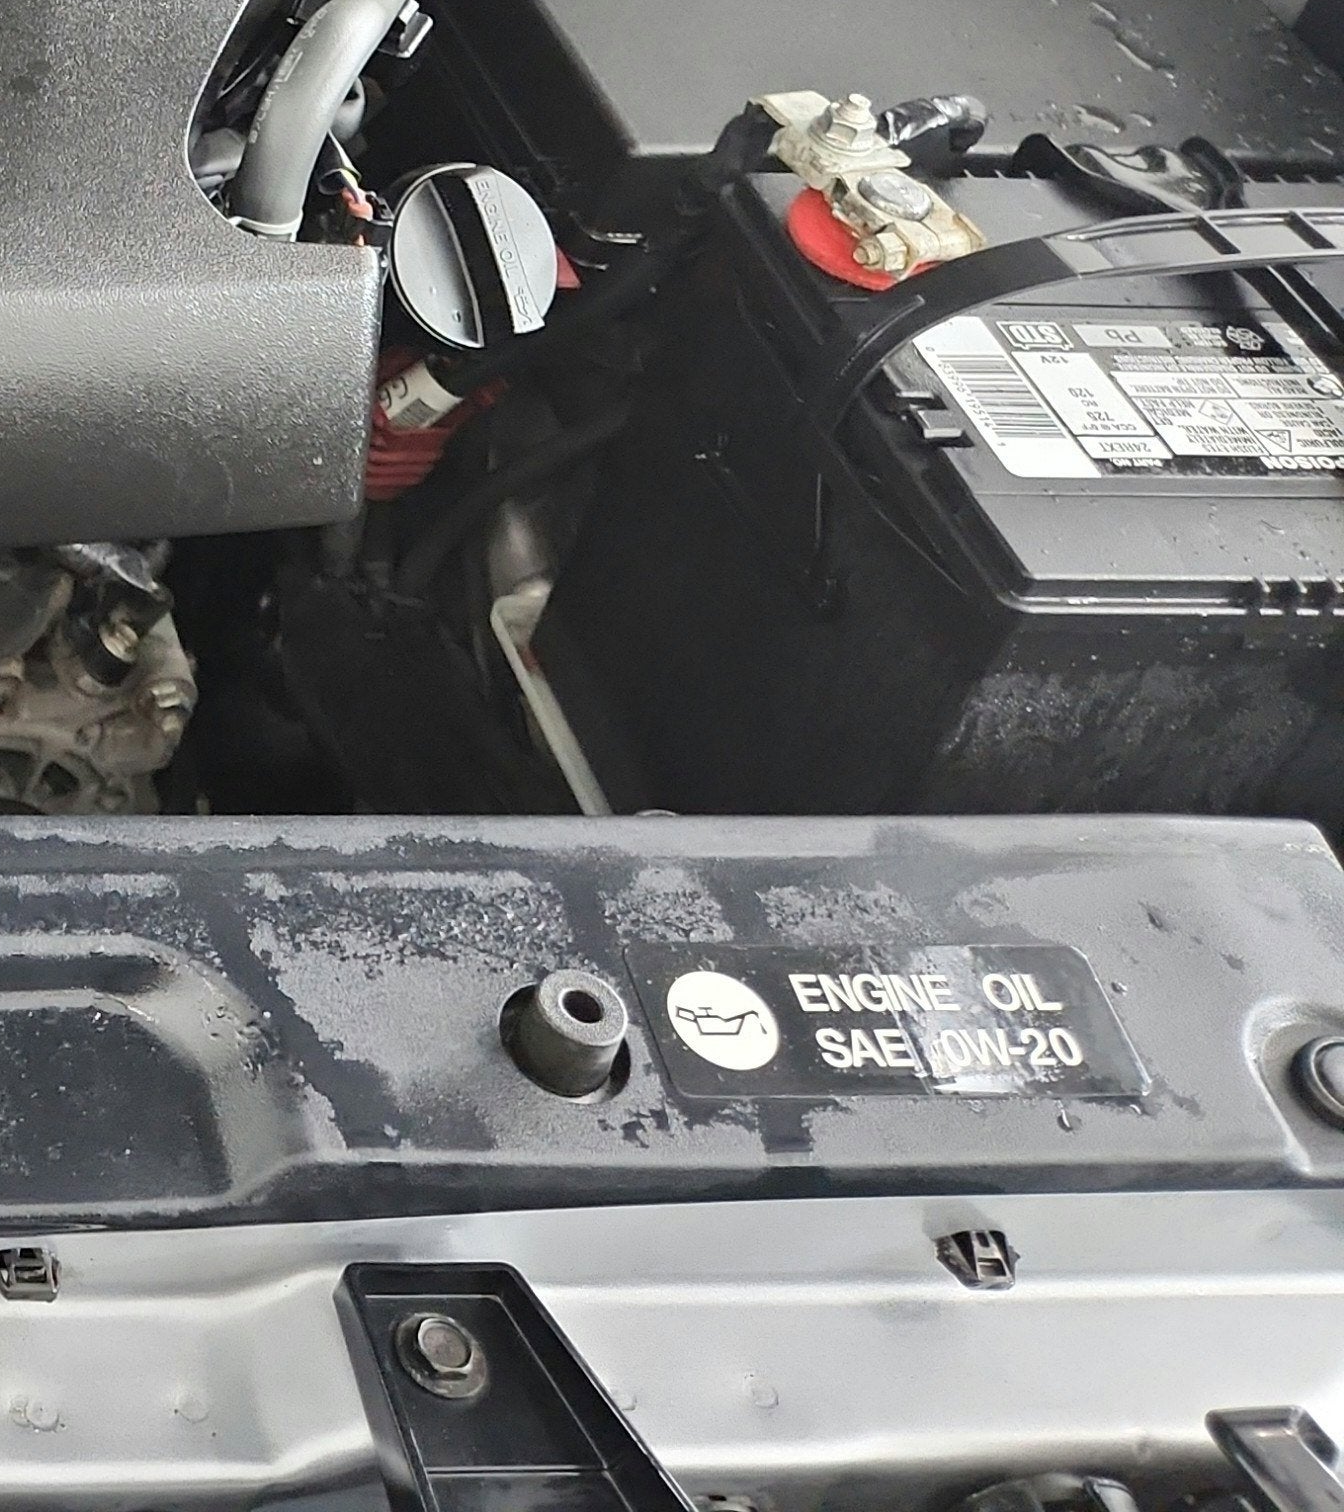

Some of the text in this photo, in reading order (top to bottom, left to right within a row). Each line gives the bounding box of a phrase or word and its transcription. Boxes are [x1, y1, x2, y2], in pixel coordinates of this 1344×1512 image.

[473, 178, 520, 279] ENGINE OIL
[1006, 326, 1065, 344] STD
[1102, 330, 1143, 343] Pb
[1037, 356, 1071, 364] 12V
[1066, 388, 1097, 398] 120
[1085, 412, 1117, 422] 725
[787, 972, 1064, 1013] ENGINE OIL
[814, 1026, 1085, 1070] SAE 0W-20
